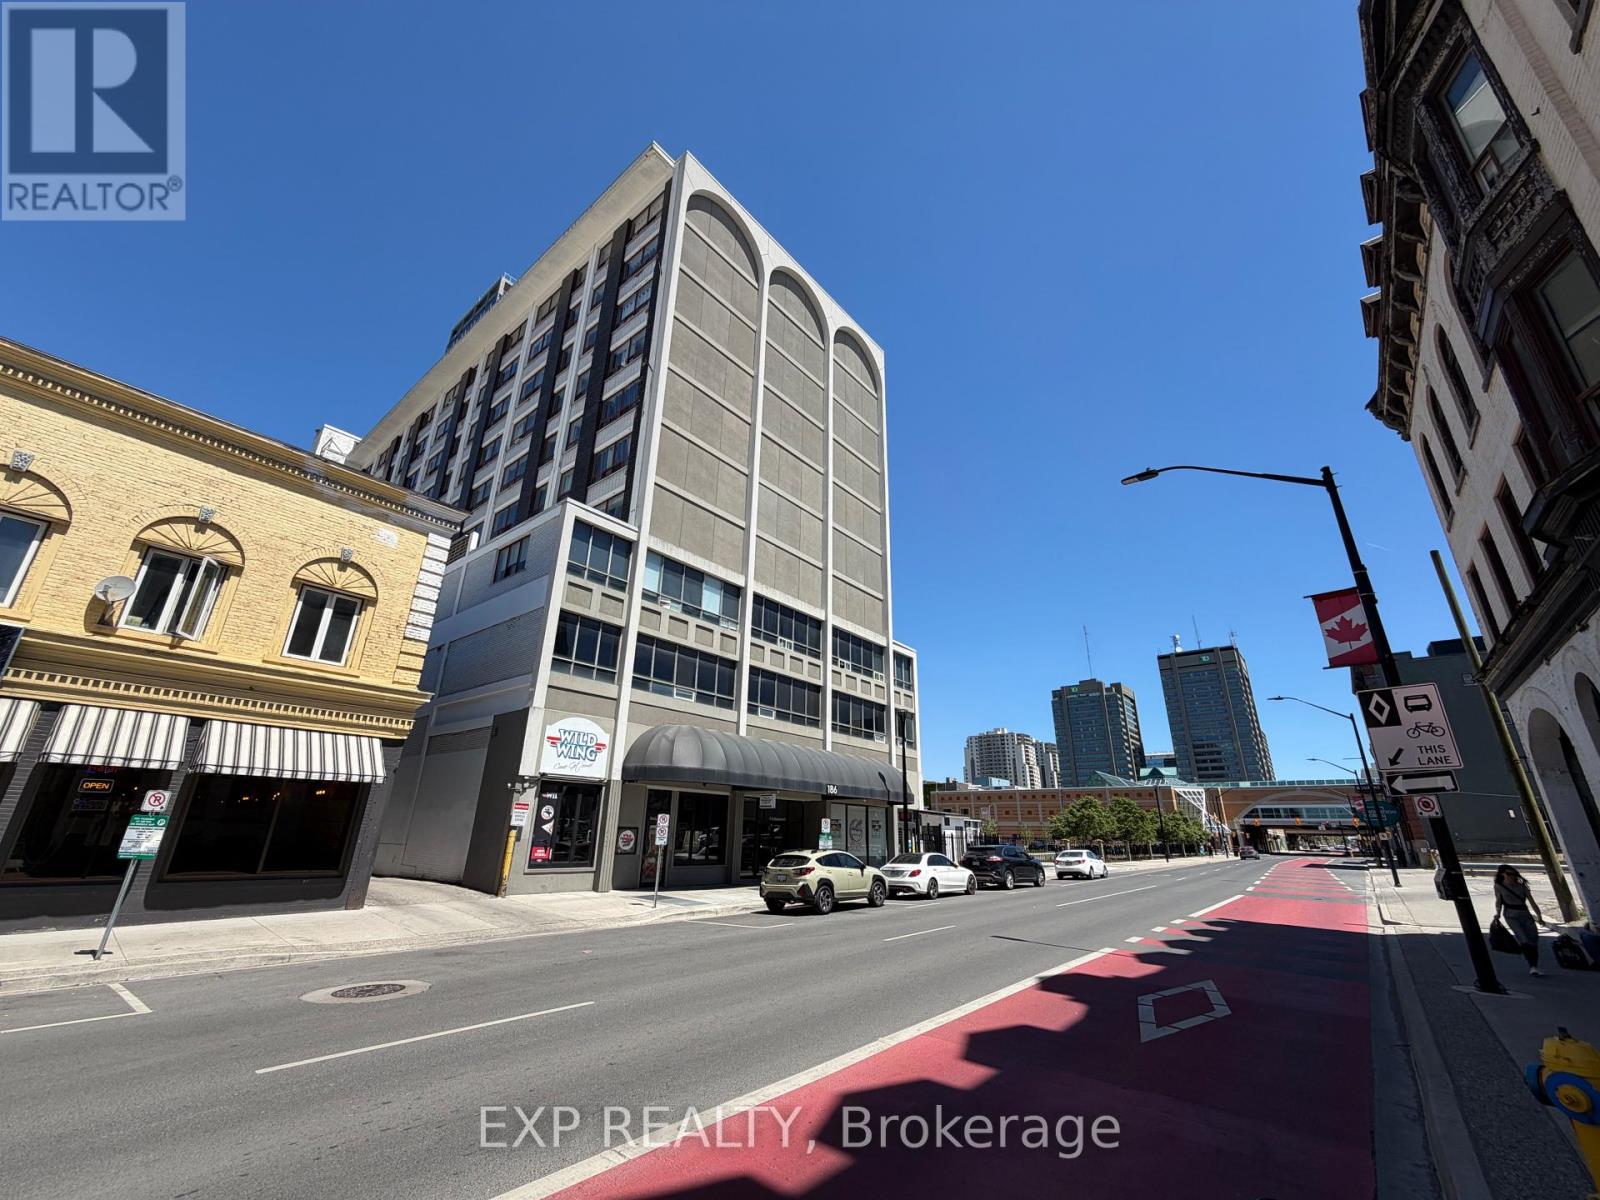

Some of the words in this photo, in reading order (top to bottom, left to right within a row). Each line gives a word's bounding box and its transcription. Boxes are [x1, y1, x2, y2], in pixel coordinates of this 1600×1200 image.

[558, 728, 598, 747] WILD
[556, 742, 598, 762] WING
[1417, 744, 1446, 755] THIS
[1417, 755, 1453, 766] LANE
[83, 782, 110, 790] OPEN
[827, 784, 838, 794] 186
